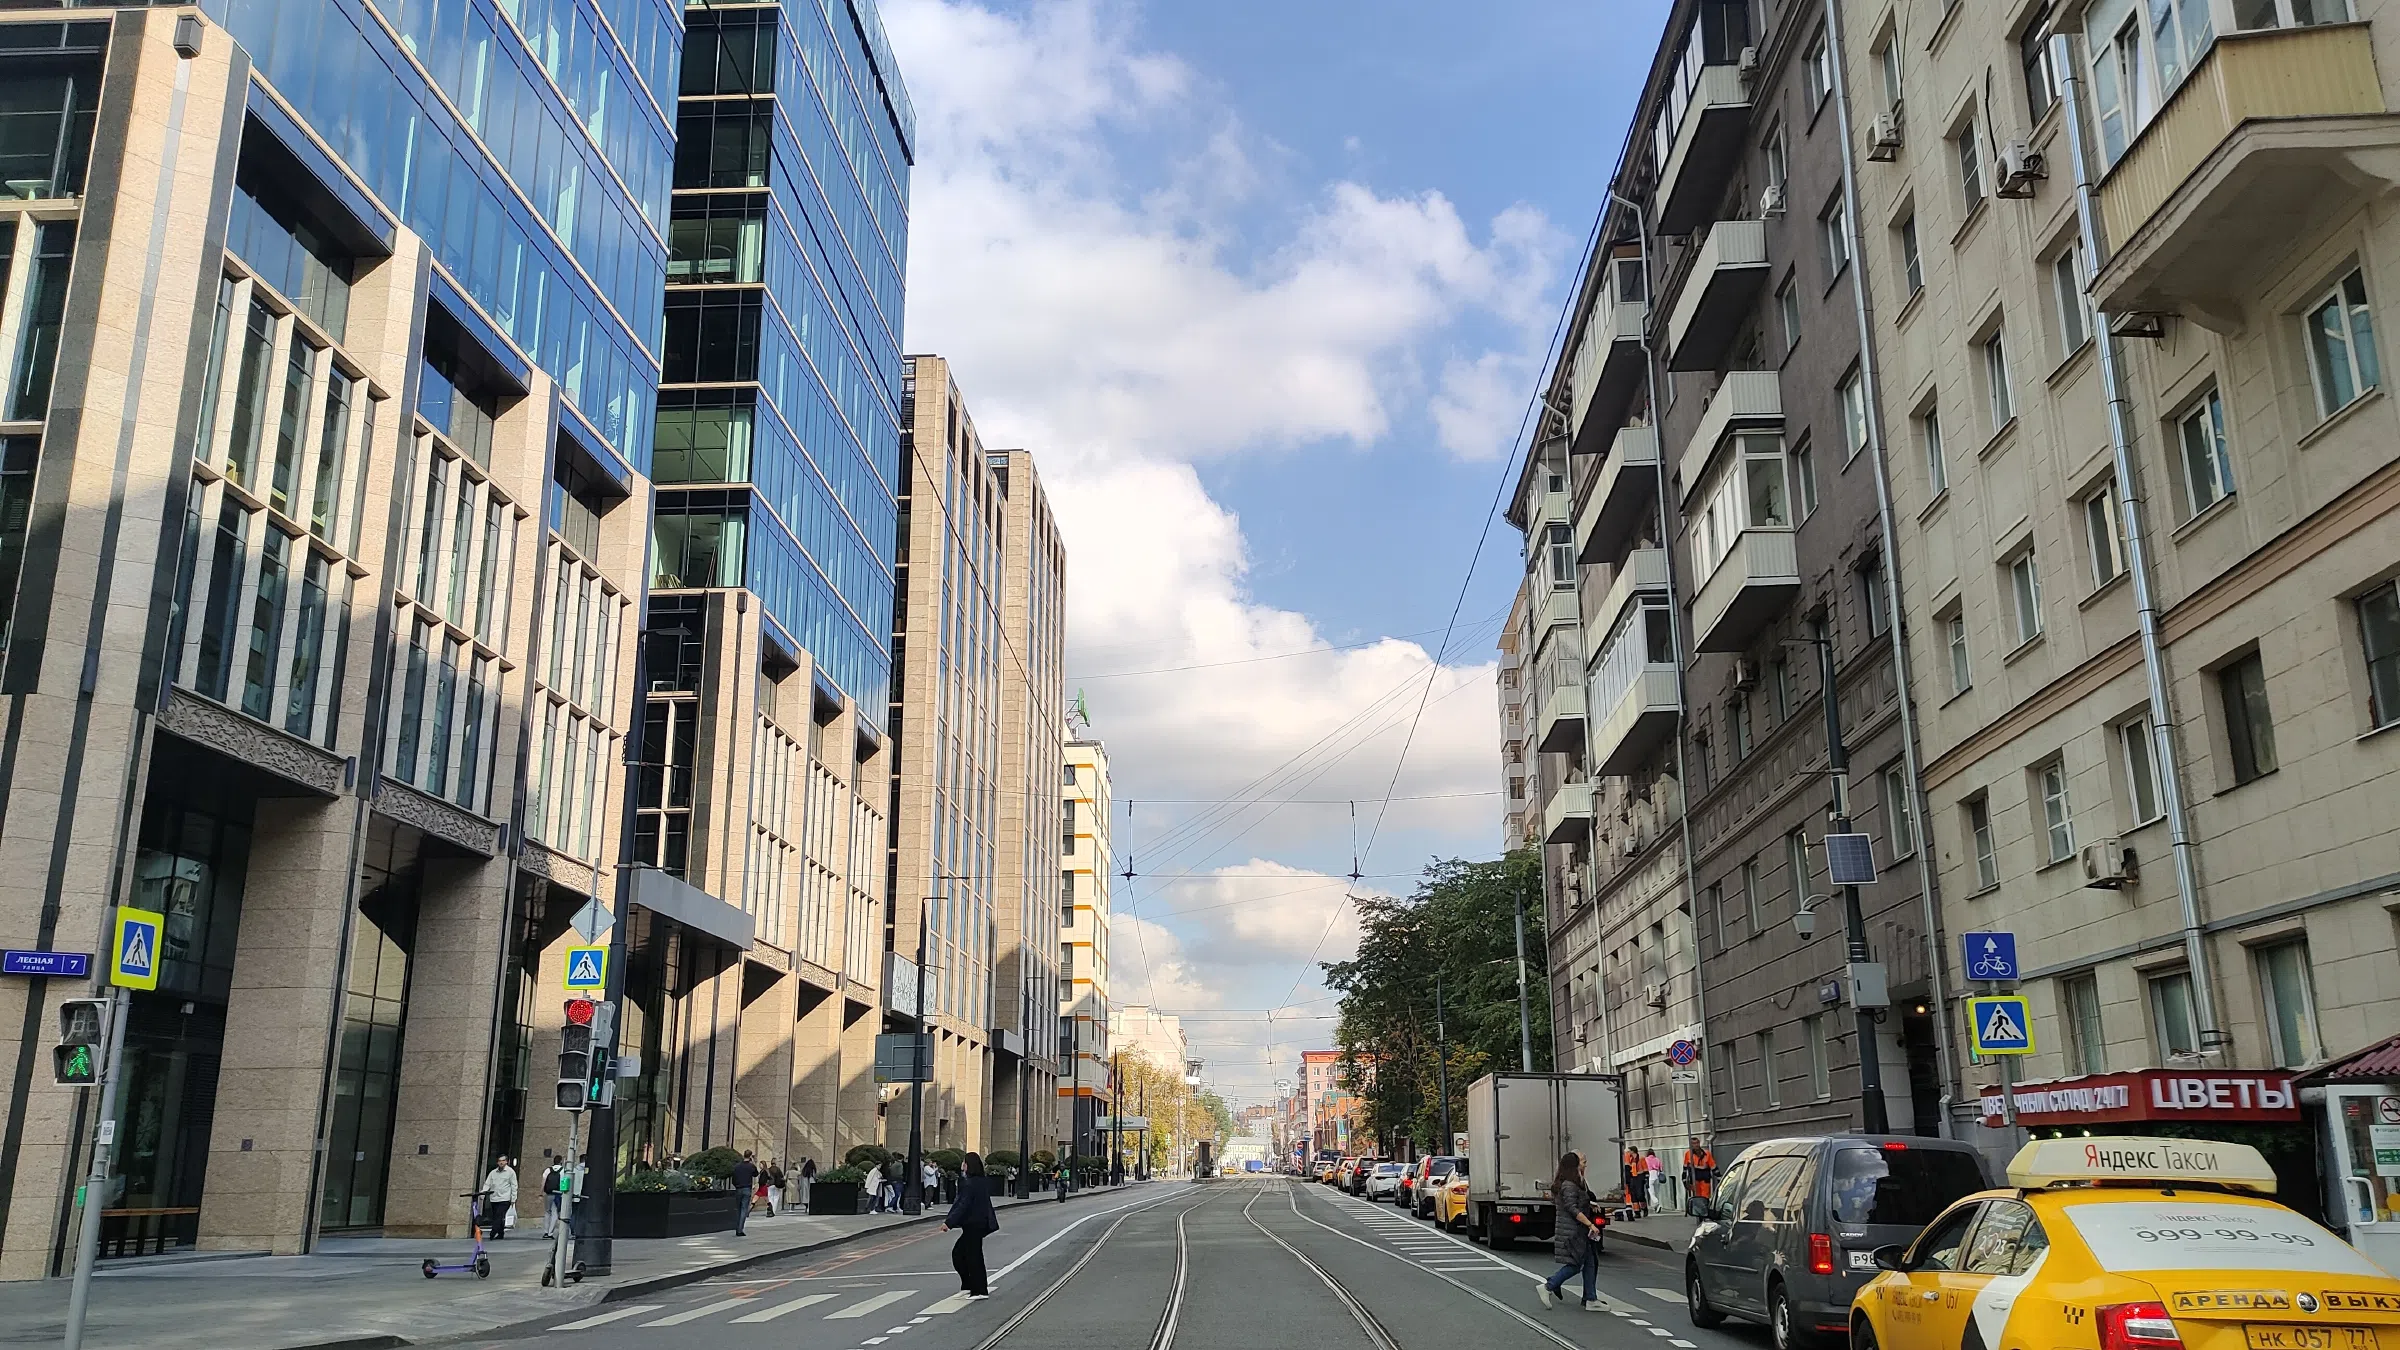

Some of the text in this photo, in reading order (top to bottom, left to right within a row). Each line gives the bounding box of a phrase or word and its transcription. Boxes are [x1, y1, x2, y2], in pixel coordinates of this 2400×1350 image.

[16, 956, 78, 970] ЛЕСНАЯ 7
[2050, 1088, 2095, 1112] СКЛАД
[2151, 1078, 2296, 1109] ЦВЕТЫ
[2085, 1144, 2219, 1171] Яндекс Такси
[2155, 1213, 2257, 1224] Яндекс Такси
[2136, 1228, 2315, 1247] 999-99-99
[1946, 1288, 1960, 1309] 057
[2179, 1294, 2289, 1309] АРЕНДА
[2259, 1329, 2365, 1349] НК 057 77
